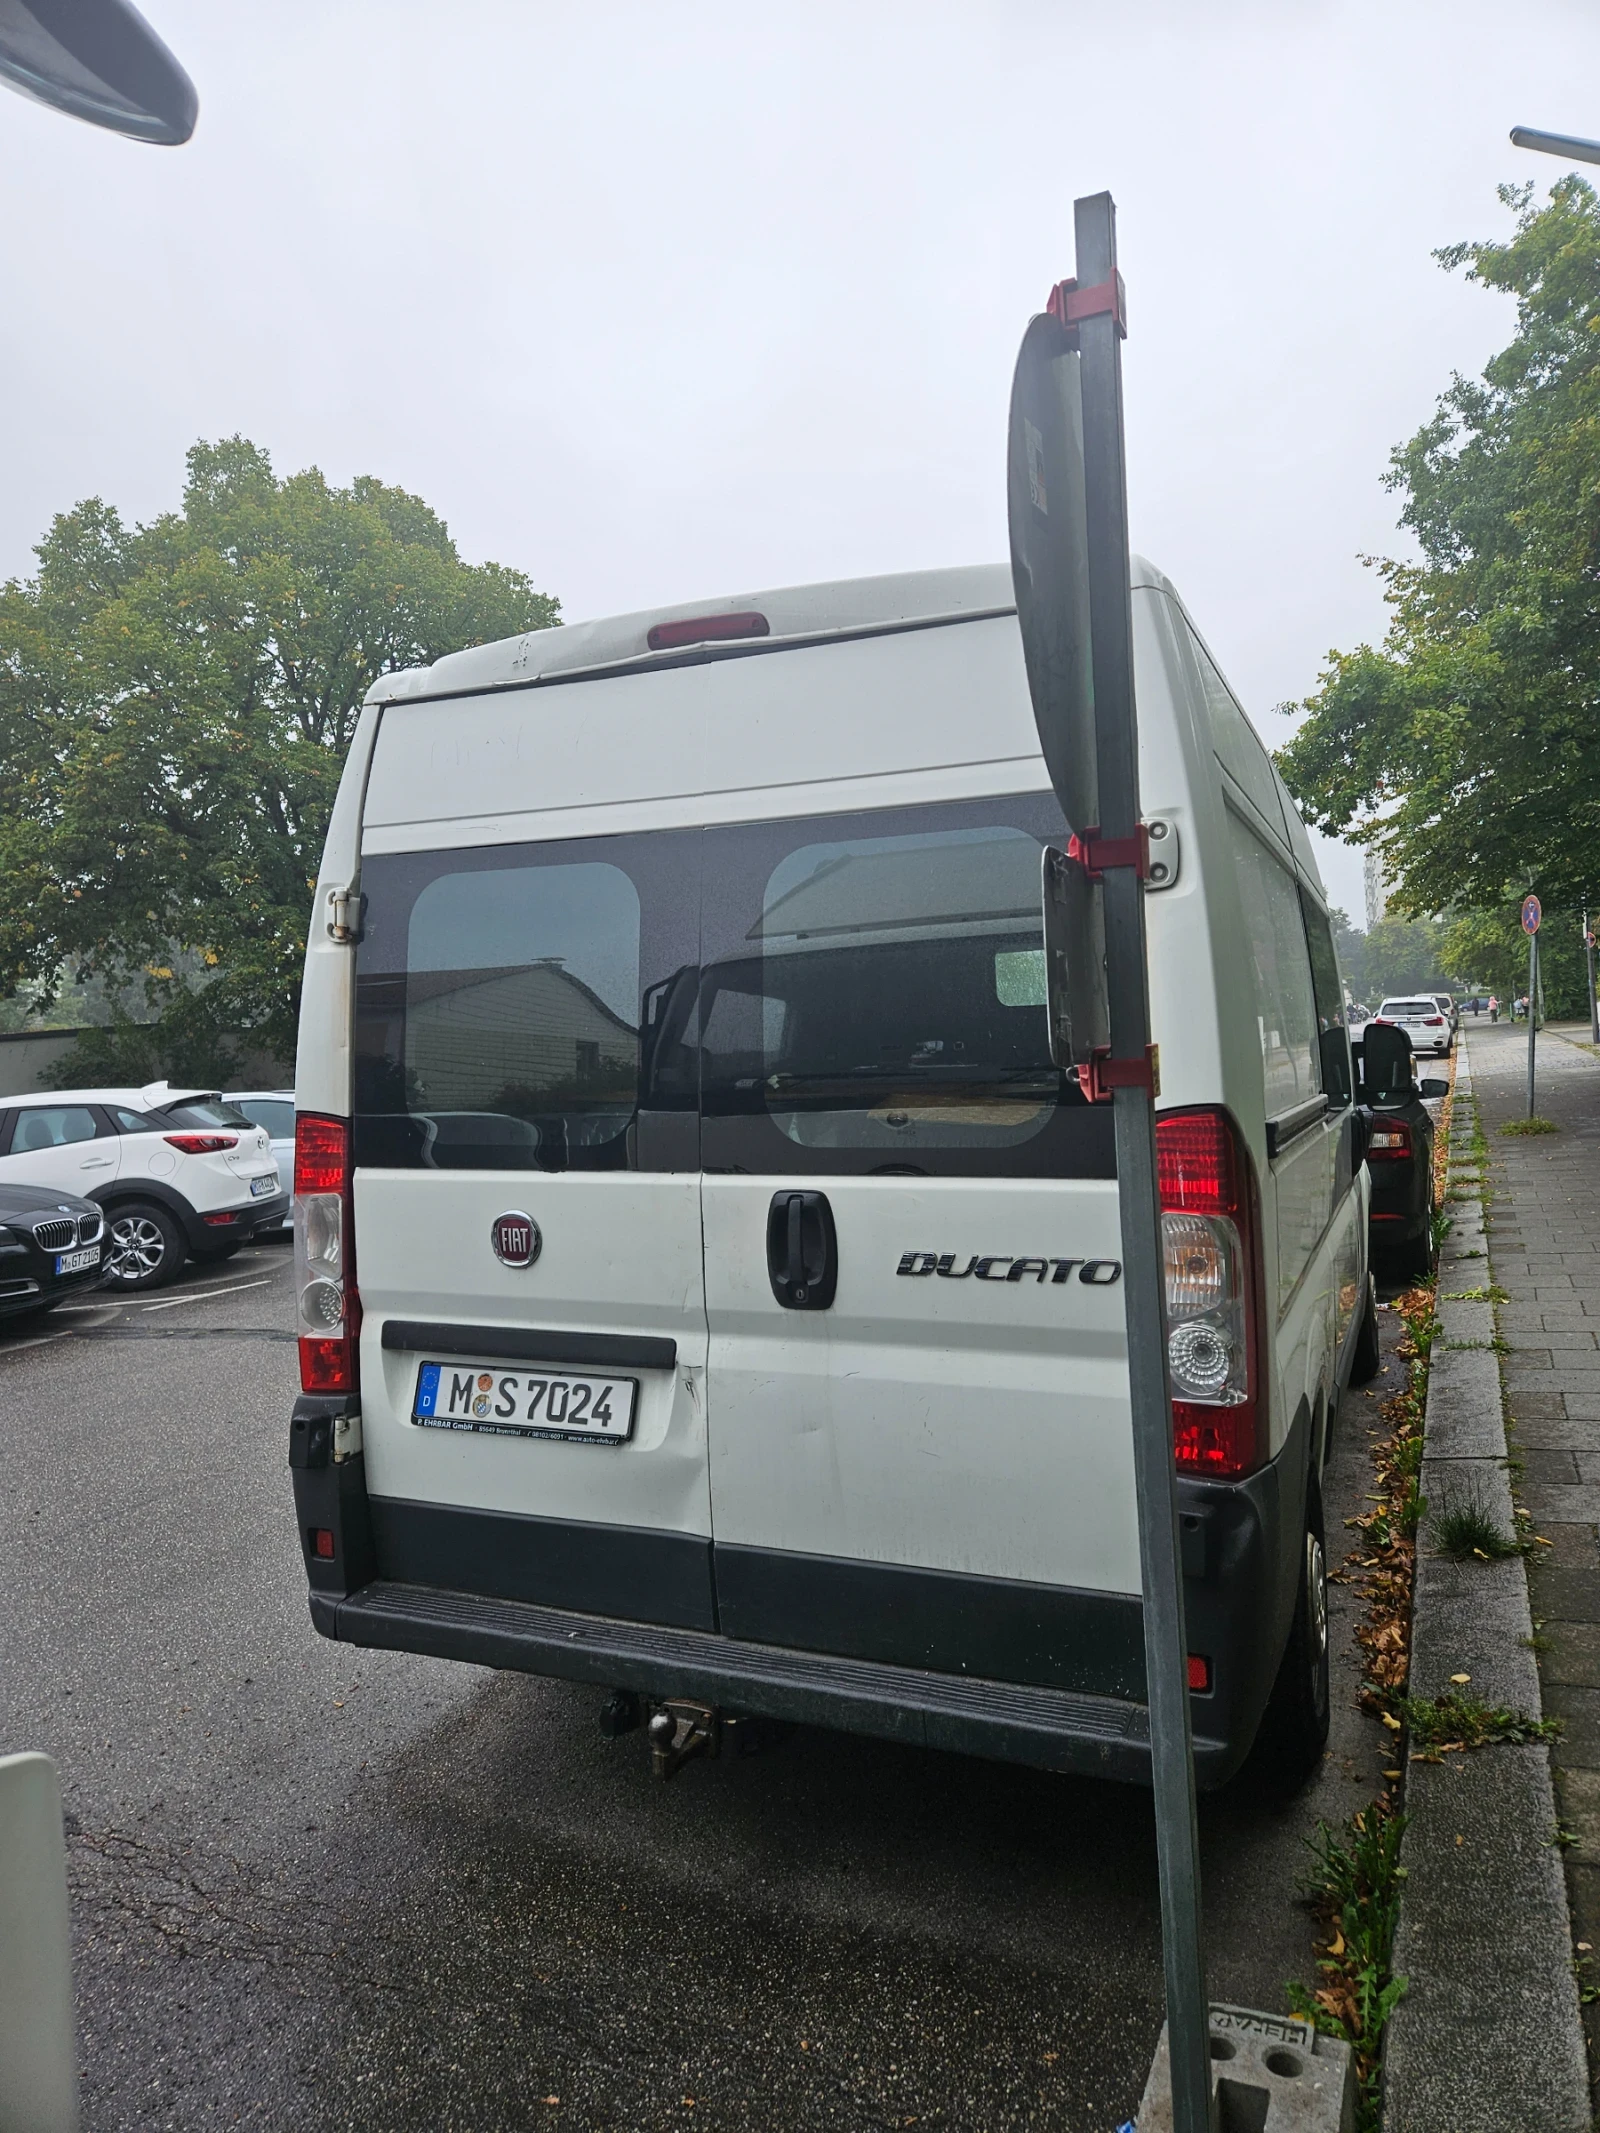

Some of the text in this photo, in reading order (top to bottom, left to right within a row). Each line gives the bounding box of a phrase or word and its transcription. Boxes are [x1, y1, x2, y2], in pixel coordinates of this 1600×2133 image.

[501, 1227, 529, 1253] FIAT
[61, 1257, 68, 1270] M
[72, 1253, 83, 1268] GT
[896, 1250, 1122, 1285] DUCATO
[423, 1395, 430, 1407] D
[449, 1373, 613, 1427] M S 7024
[424, 1418, 452, 1429] EHRBAR
[452, 1422, 473, 1431] GmbH
